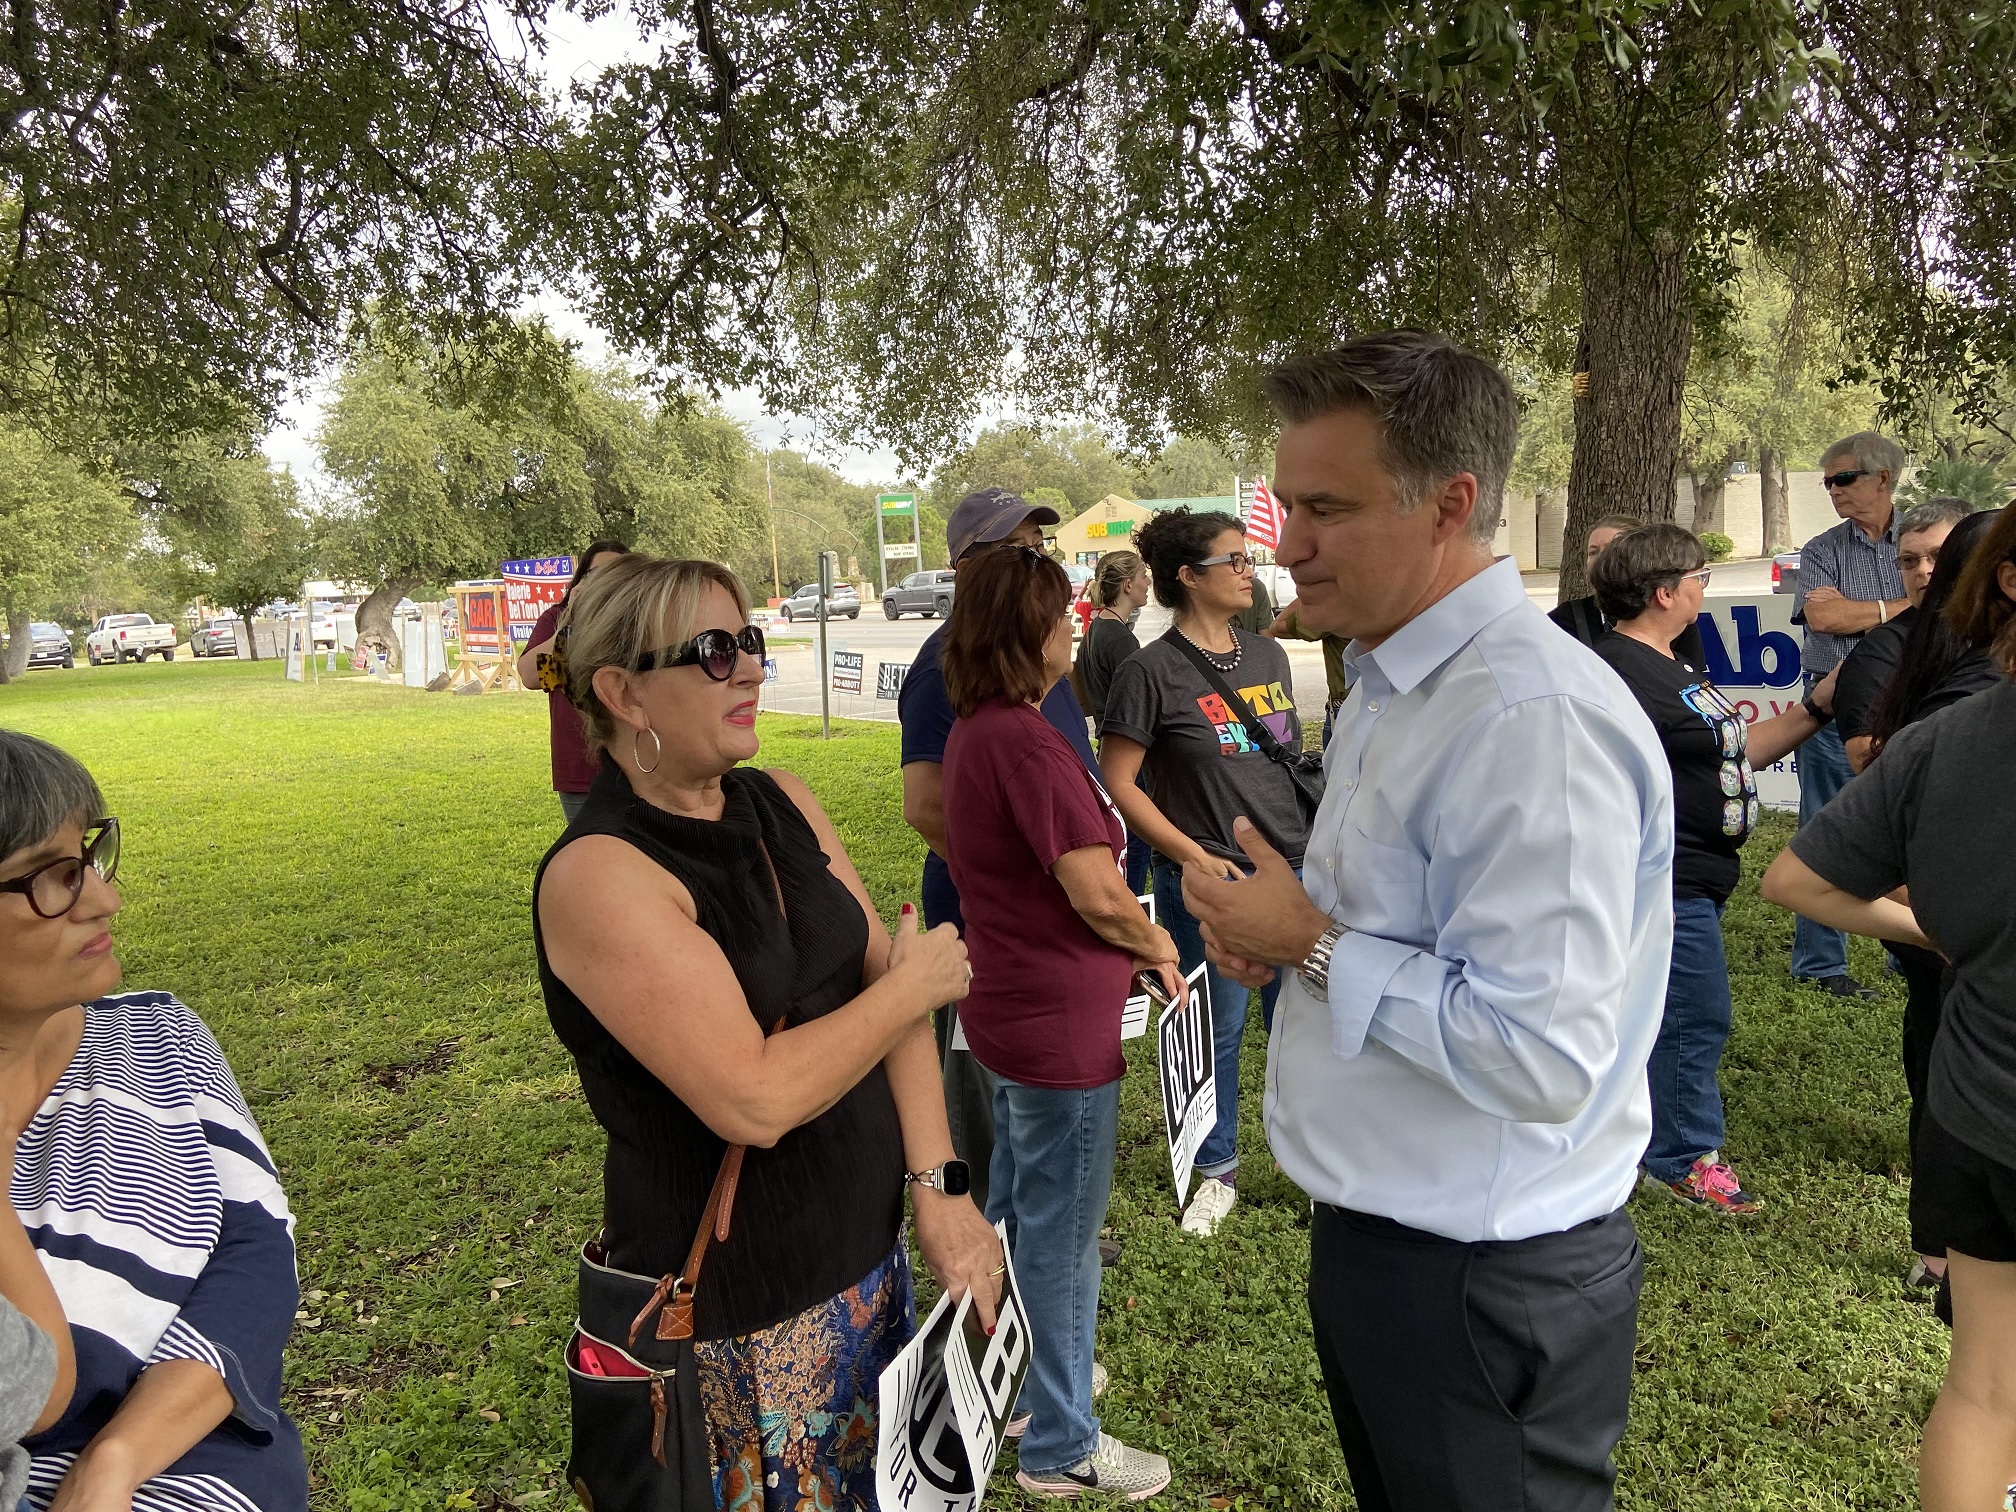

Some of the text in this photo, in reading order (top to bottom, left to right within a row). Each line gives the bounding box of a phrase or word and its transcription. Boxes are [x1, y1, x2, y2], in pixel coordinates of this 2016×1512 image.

[882, 501, 912, 509] SUBWAY
[1087, 519, 1135, 538] SUBWAY
[505, 582, 532, 601] Valerie
[508, 601, 521, 620] Del
[520, 601, 539, 619] Toro
[835, 654, 862, 667] PRO-LIFE
[833, 678, 860, 689] PRO-ABBOTT
